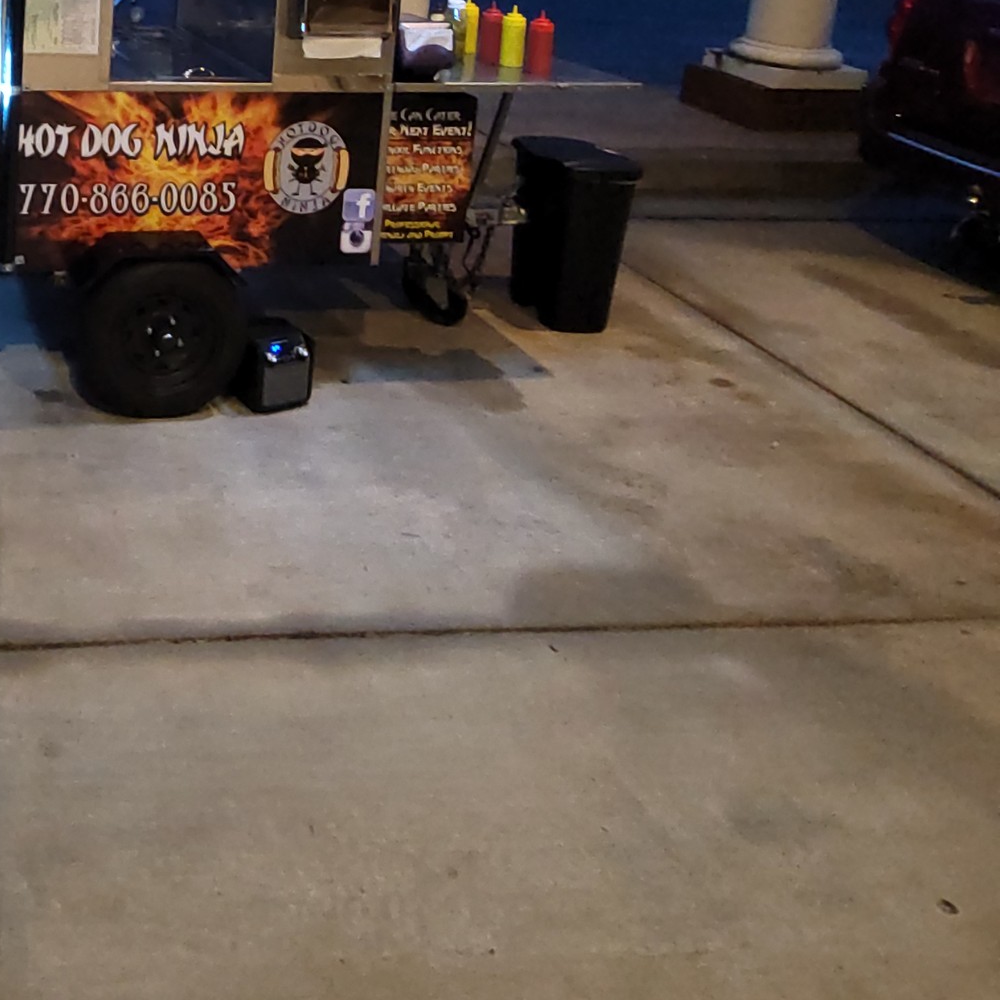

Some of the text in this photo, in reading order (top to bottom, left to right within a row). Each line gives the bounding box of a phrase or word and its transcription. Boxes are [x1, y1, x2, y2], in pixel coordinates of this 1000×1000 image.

[18, 121, 245, 160] HOT DOG NINJA
[19, 181, 237, 216] 770-866-0085
